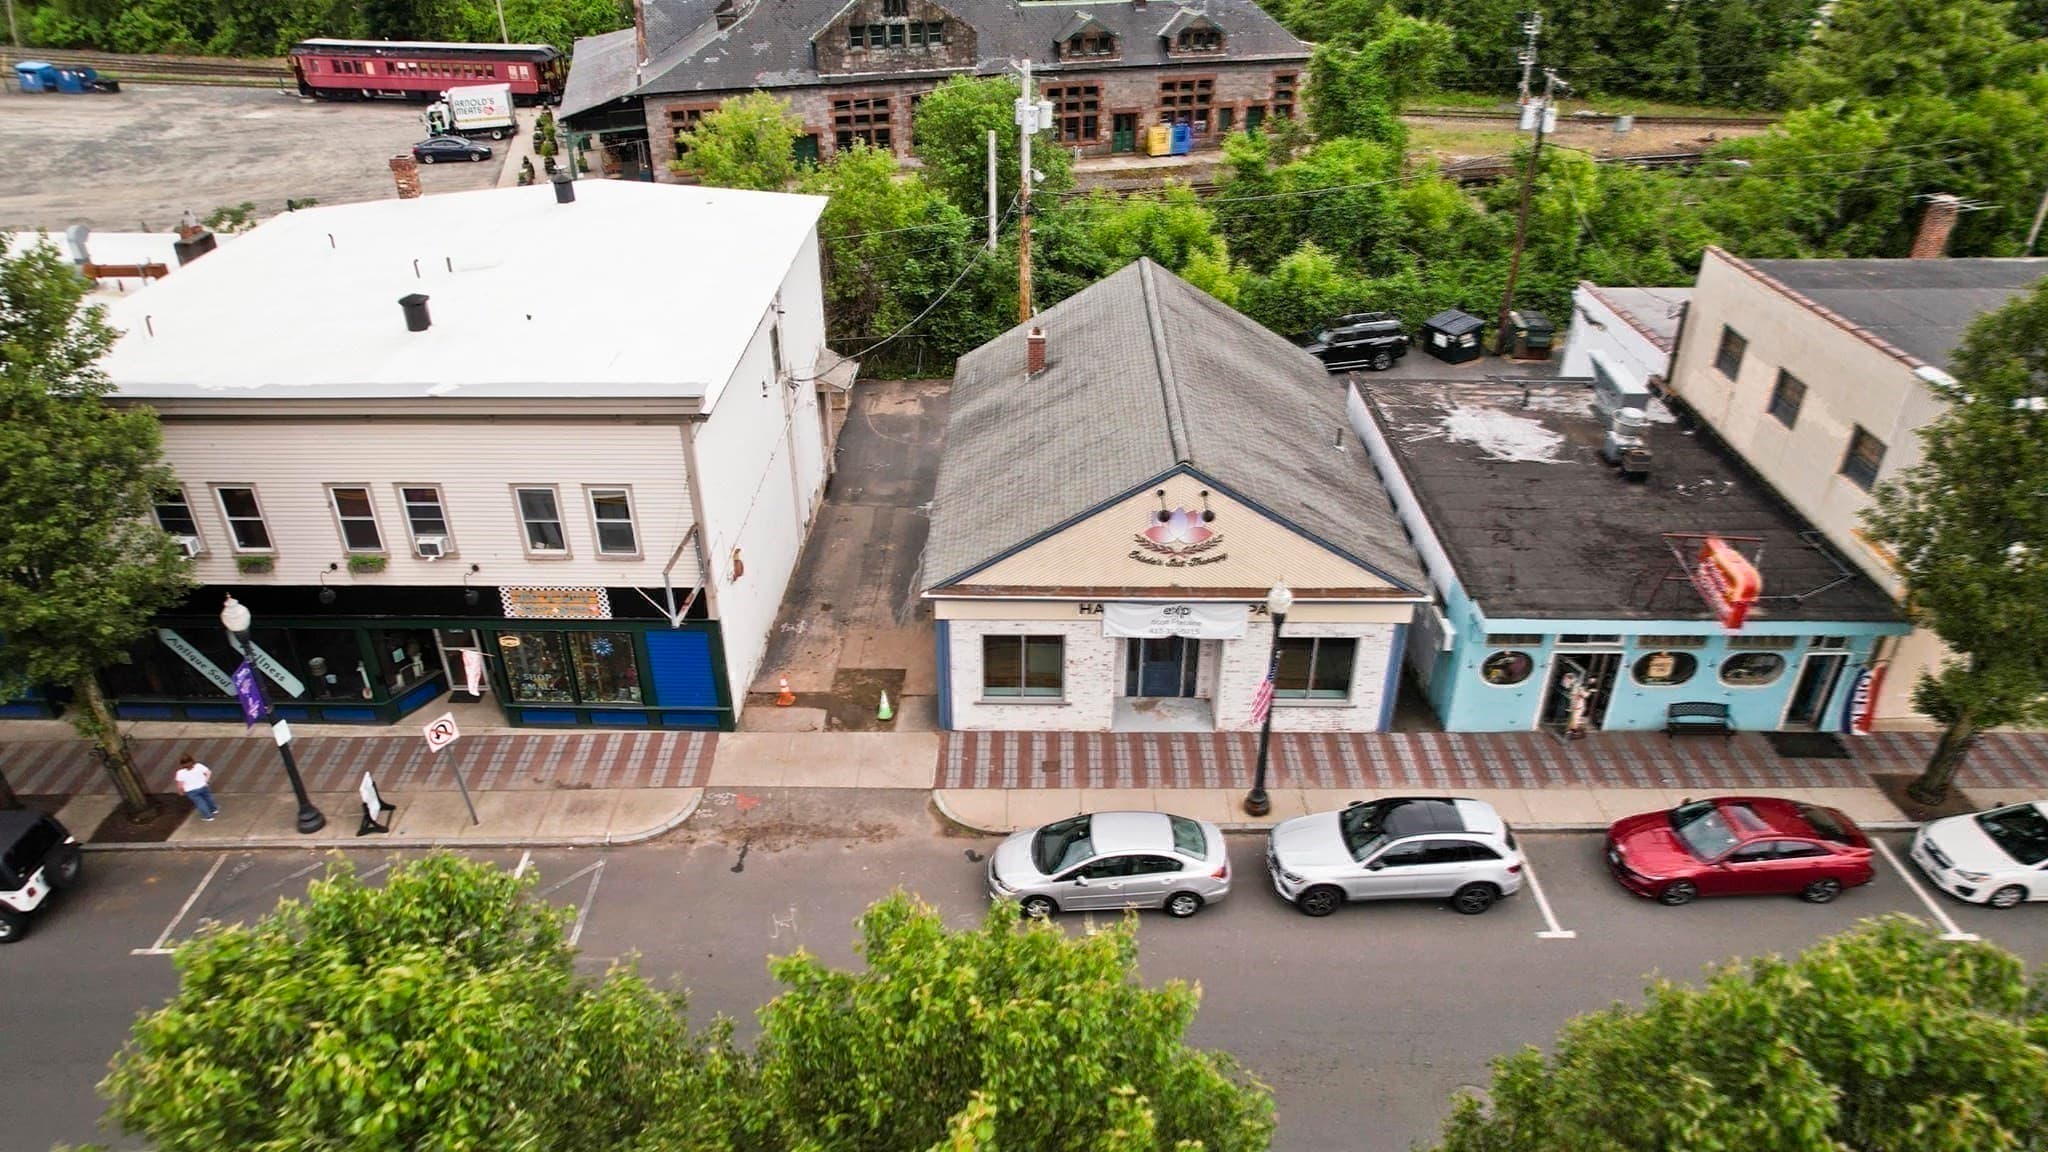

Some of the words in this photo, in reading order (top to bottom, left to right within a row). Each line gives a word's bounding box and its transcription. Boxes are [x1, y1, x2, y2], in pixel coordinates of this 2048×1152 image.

[454, 97, 495, 107] ARNOLD'S
[456, 106, 482, 115] MEATS
[166, 637, 207, 669] Antique
[208, 668, 232, 688] Soul
[522, 673, 553, 681] SHOP
